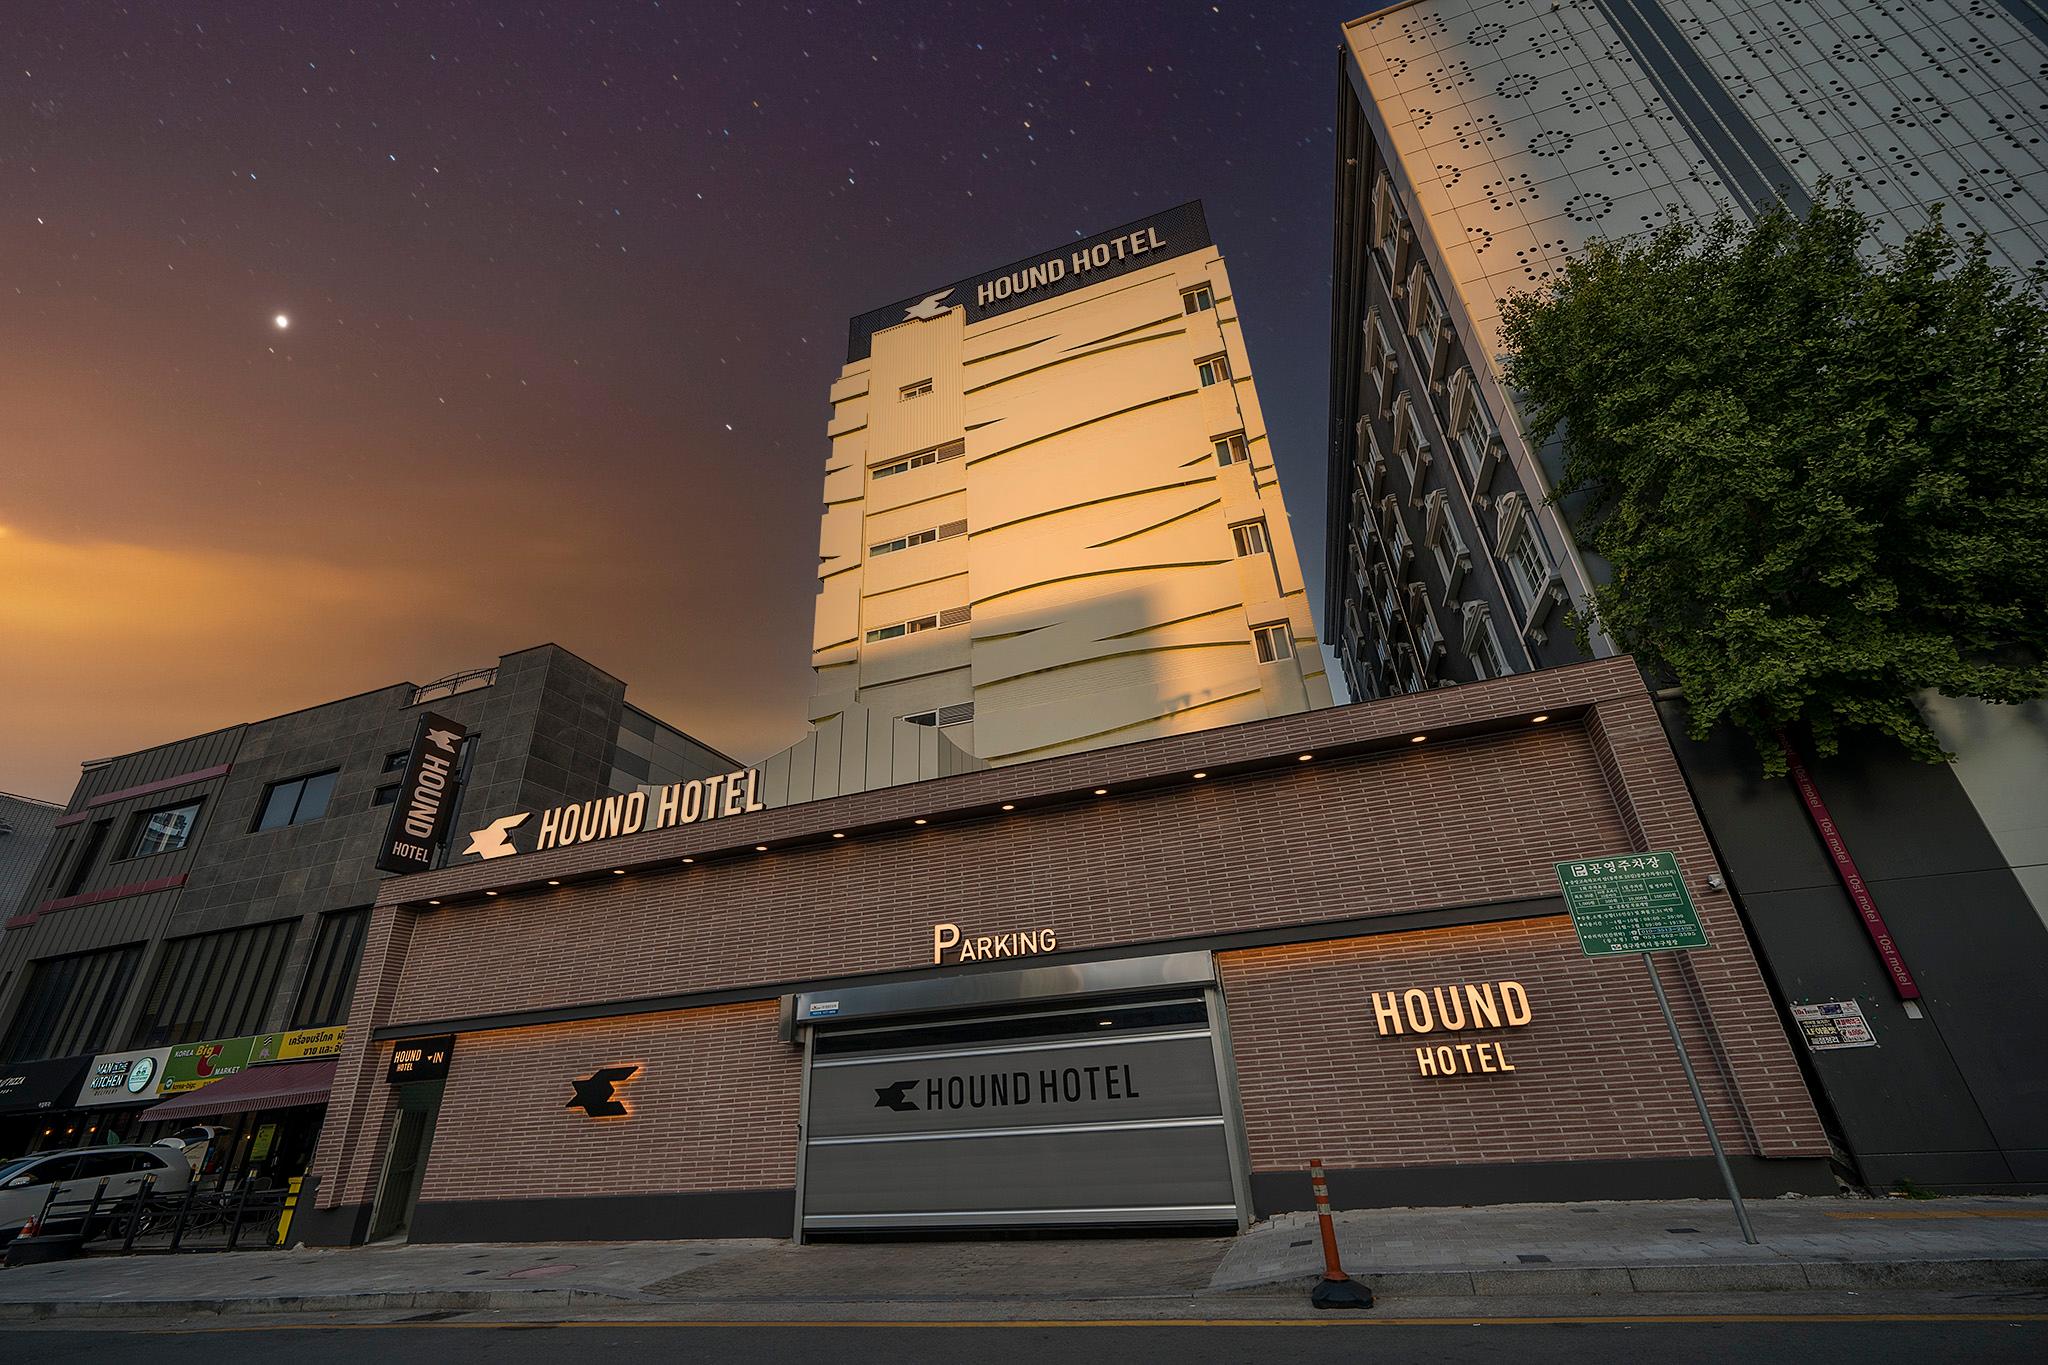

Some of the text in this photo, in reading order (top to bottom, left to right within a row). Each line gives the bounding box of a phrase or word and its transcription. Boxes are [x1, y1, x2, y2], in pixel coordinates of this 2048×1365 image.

[977, 226, 1167, 307] HOUND HOTEL
[404, 754, 450, 839] HOUND
[537, 768, 766, 851] HOUND HOTEL
[392, 841, 429, 864] HOTEL
[1828, 837, 1849, 864] motel
[1590, 857, 1660, 874] 공영주차장
[1858, 895, 1879, 923] motel
[1889, 957, 1911, 986] motel
[1371, 981, 1533, 1036] HOUND
[175, 1049, 194, 1058] KOREA
[195, 1044, 215, 1058] Big
[393, 1049, 444, 1064] HOUND IN
[1416, 1042, 1516, 1077] HOTEL
[215, 1066, 241, 1076] MARKET
[396, 1062, 413, 1072] HOTEL
[90, 1074, 124, 1089] KITCHEN
[927, 1064, 1140, 1111] HOUND HOTEL
